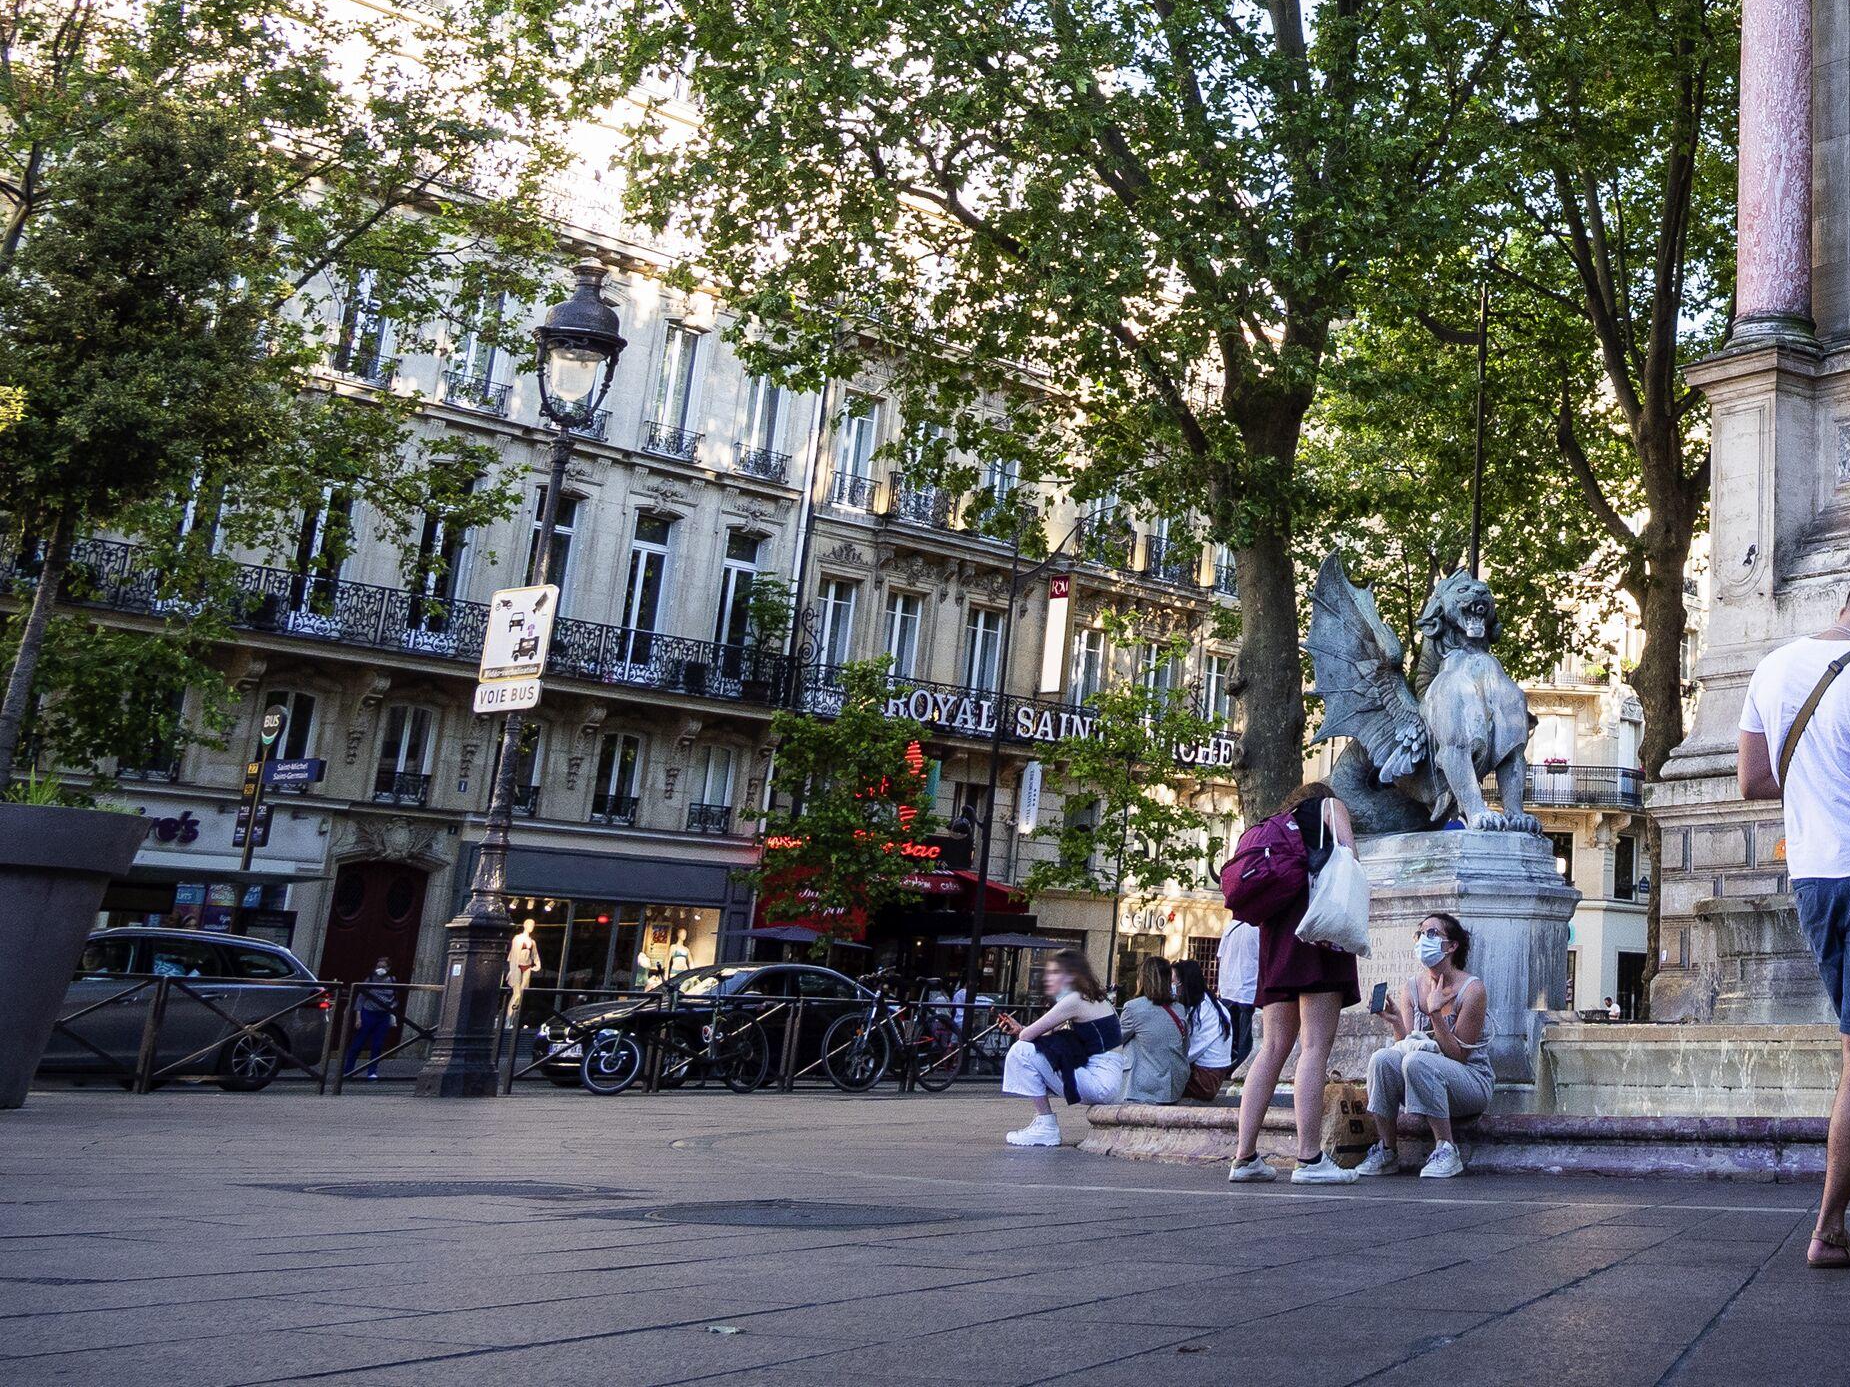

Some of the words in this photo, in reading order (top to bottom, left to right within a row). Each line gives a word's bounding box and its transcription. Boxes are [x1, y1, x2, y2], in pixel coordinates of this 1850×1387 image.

[480, 689, 507, 705] VOIE
[510, 686, 535, 702] BUS
[263, 714, 281, 728] BUS
[883, 690, 998, 732] ROYAL
[1120, 908, 1167, 931] celio
